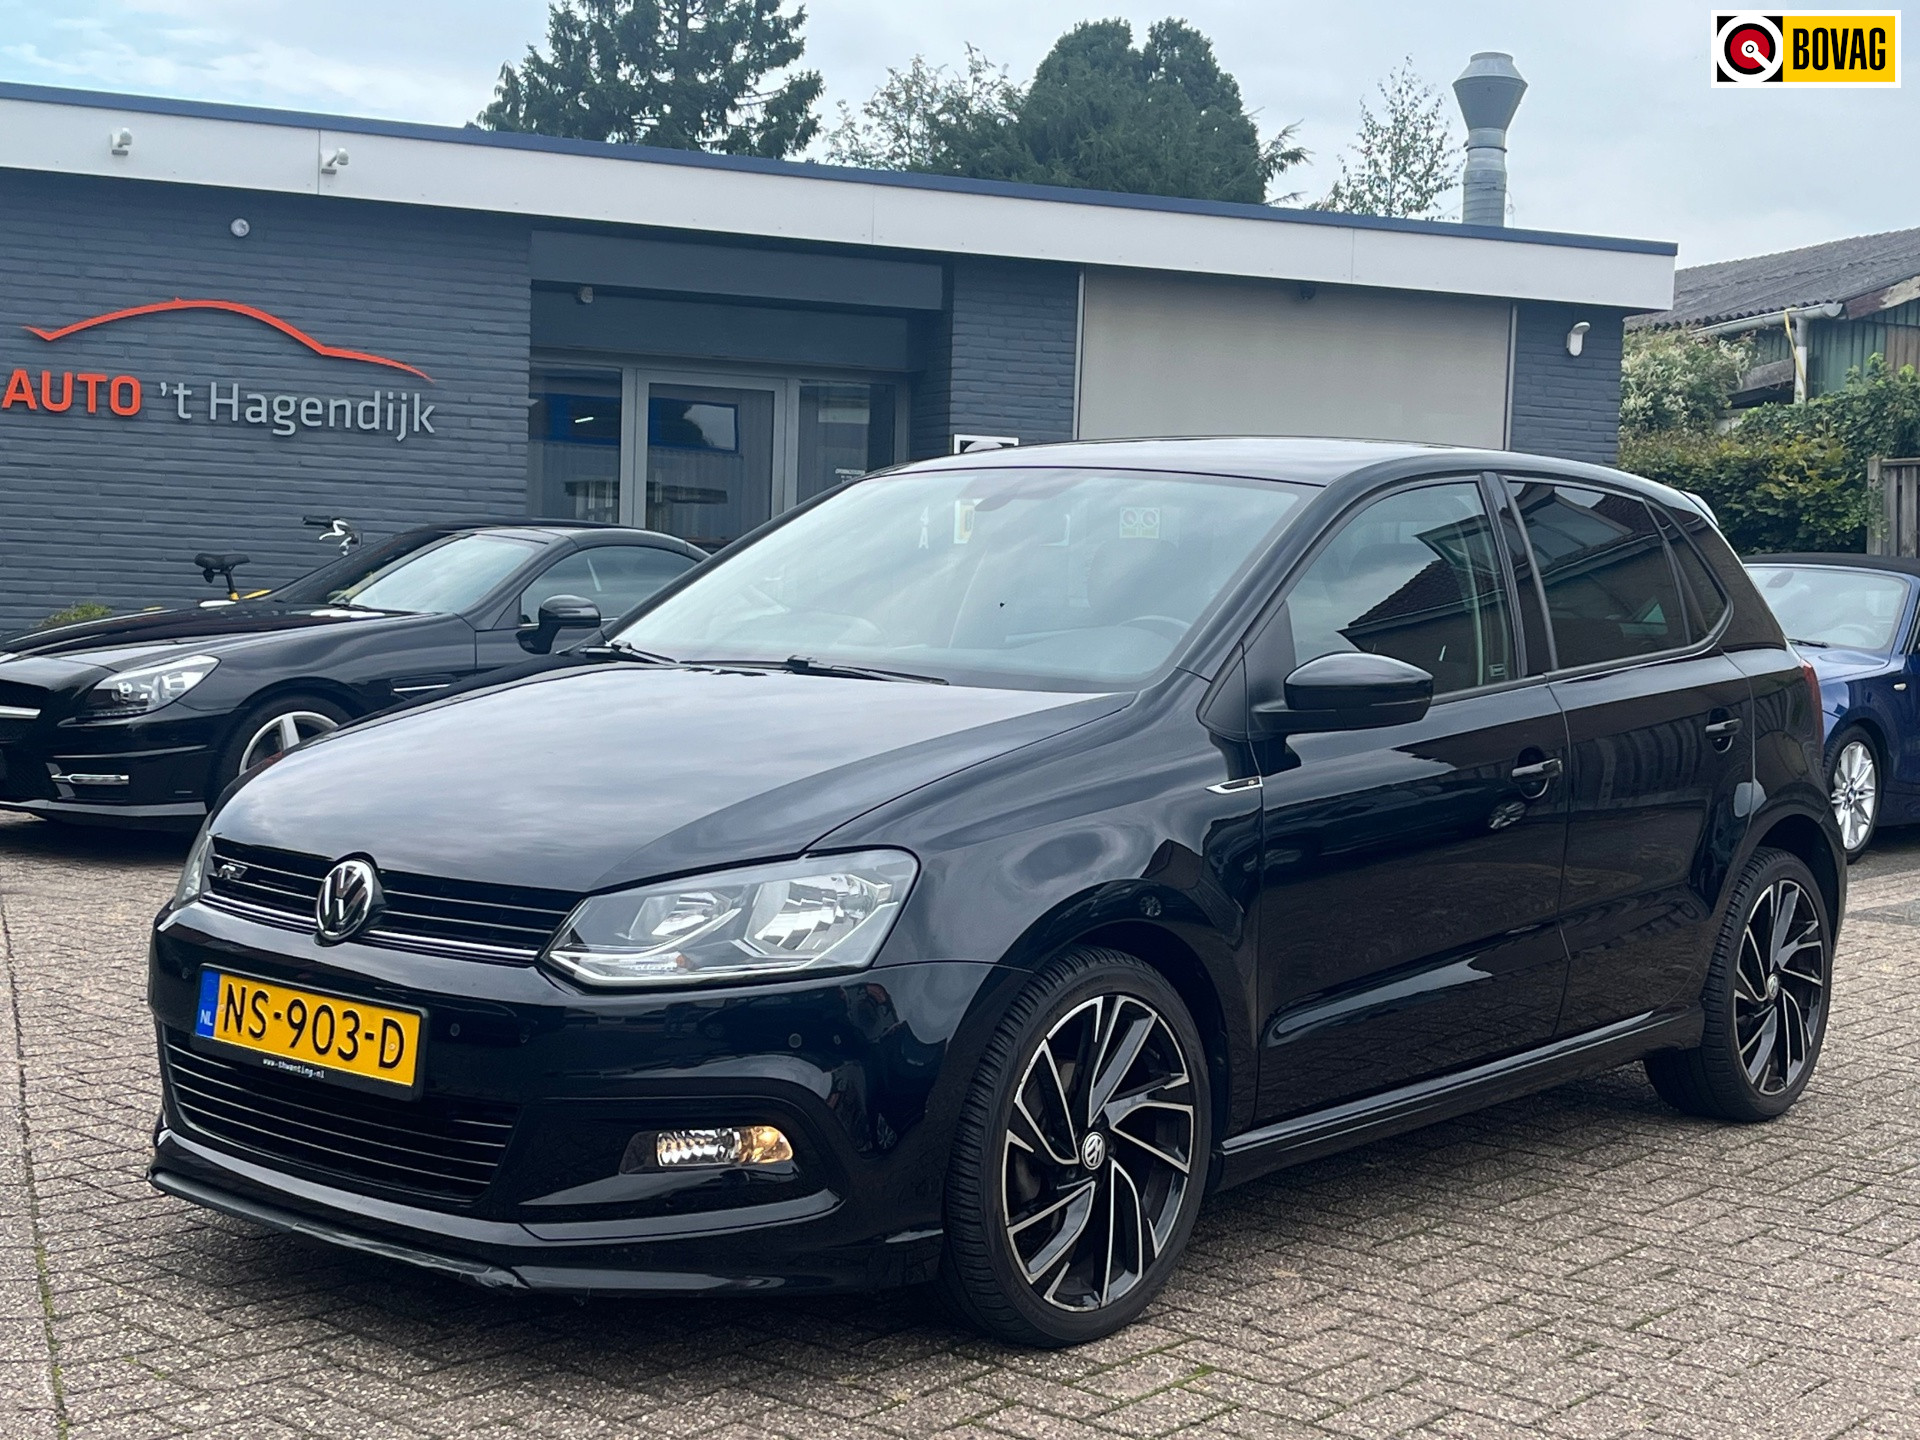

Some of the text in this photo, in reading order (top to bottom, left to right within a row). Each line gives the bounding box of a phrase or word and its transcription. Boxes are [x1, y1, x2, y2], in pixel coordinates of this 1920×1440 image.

[2, 369, 142, 416] AUTO
[210, 382, 435, 442] Hagendijk
[200, 1009, 213, 1026] NL
[223, 983, 405, 1069] NS-903-D
